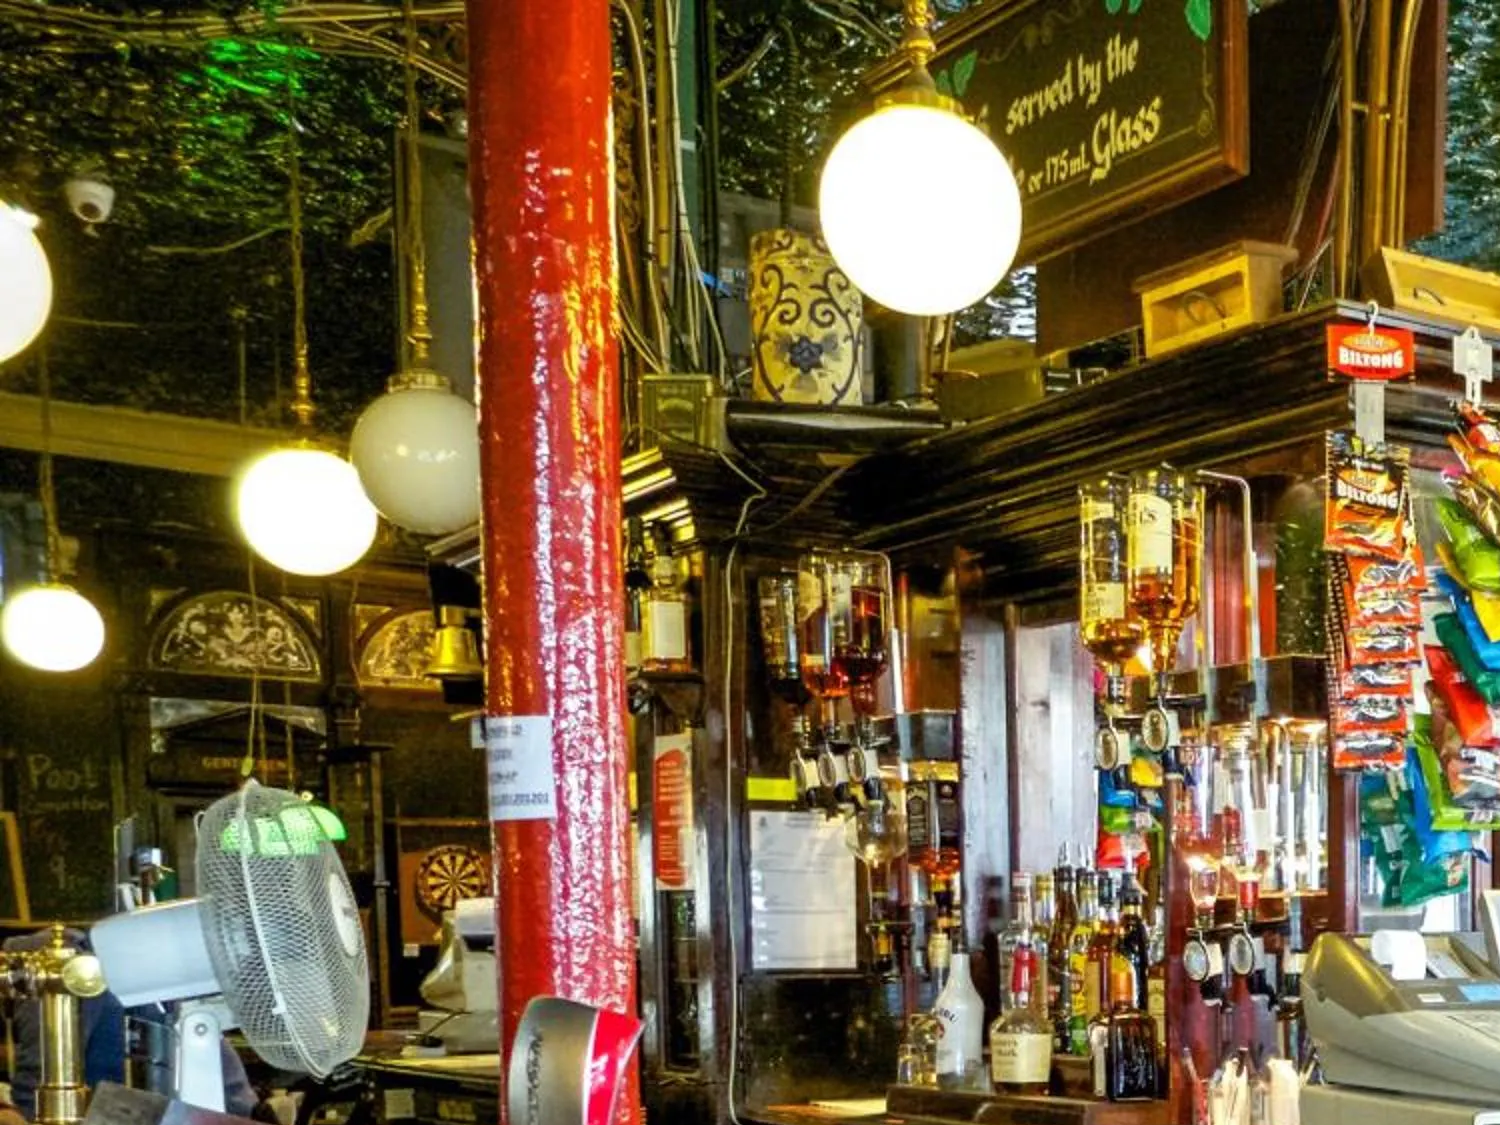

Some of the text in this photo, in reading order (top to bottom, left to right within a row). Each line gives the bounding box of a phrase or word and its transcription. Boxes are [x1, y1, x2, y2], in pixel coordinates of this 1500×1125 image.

[1005, 58, 1074, 135] served
[1077, 53, 1102, 109] by
[1105, 32, 1140, 83] the
[1088, 95, 1163, 187] Glass
[1337, 345, 1405, 370] BILTONG
[1335, 478, 1400, 510] BILTONG
